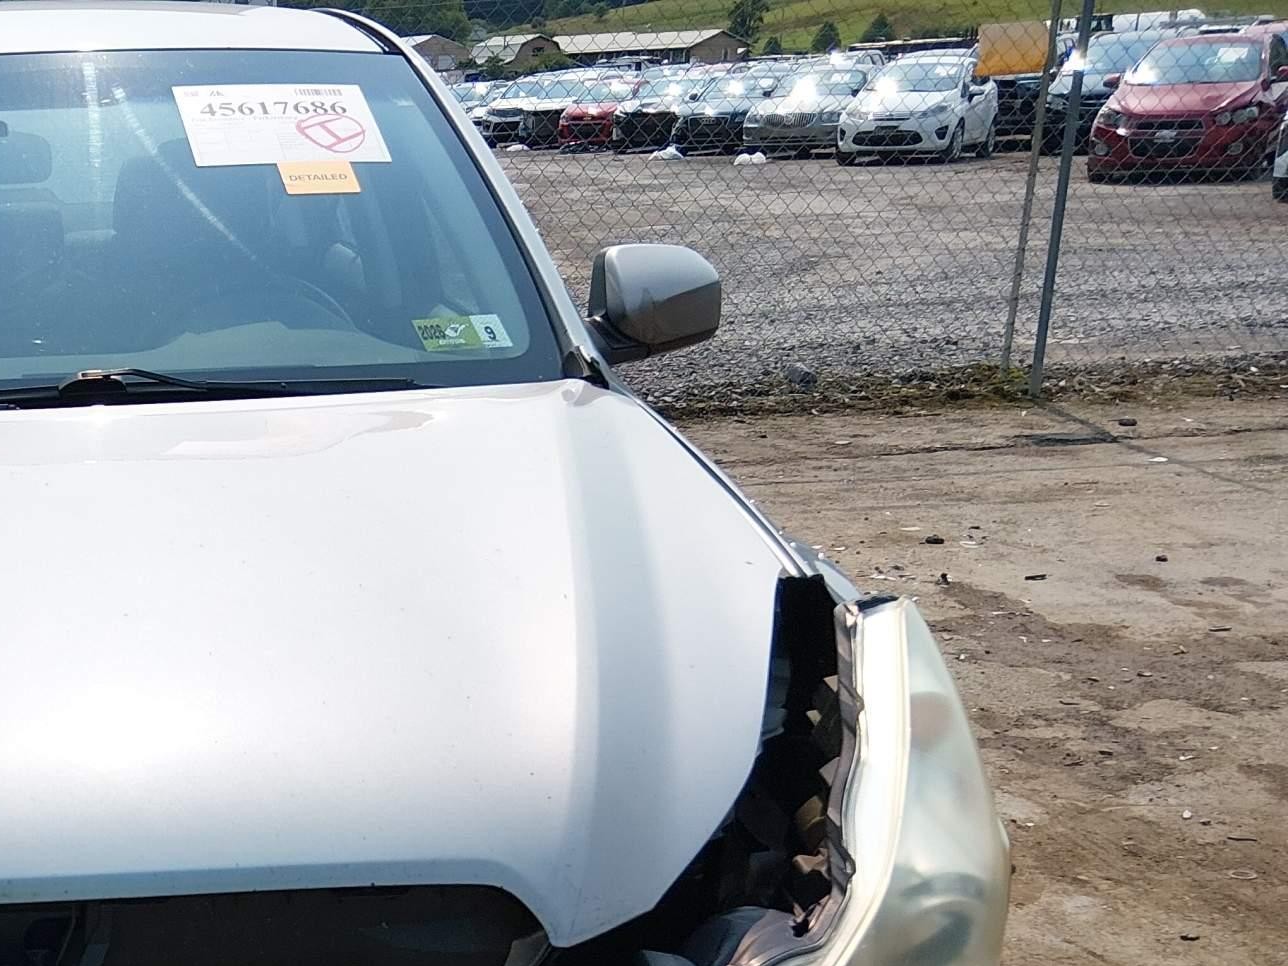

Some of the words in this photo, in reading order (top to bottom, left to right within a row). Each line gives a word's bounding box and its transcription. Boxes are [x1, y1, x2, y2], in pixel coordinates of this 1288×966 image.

[200, 101, 348, 117] 45617686
[288, 173, 349, 182] DETAILED
[484, 325, 497, 342] 9
